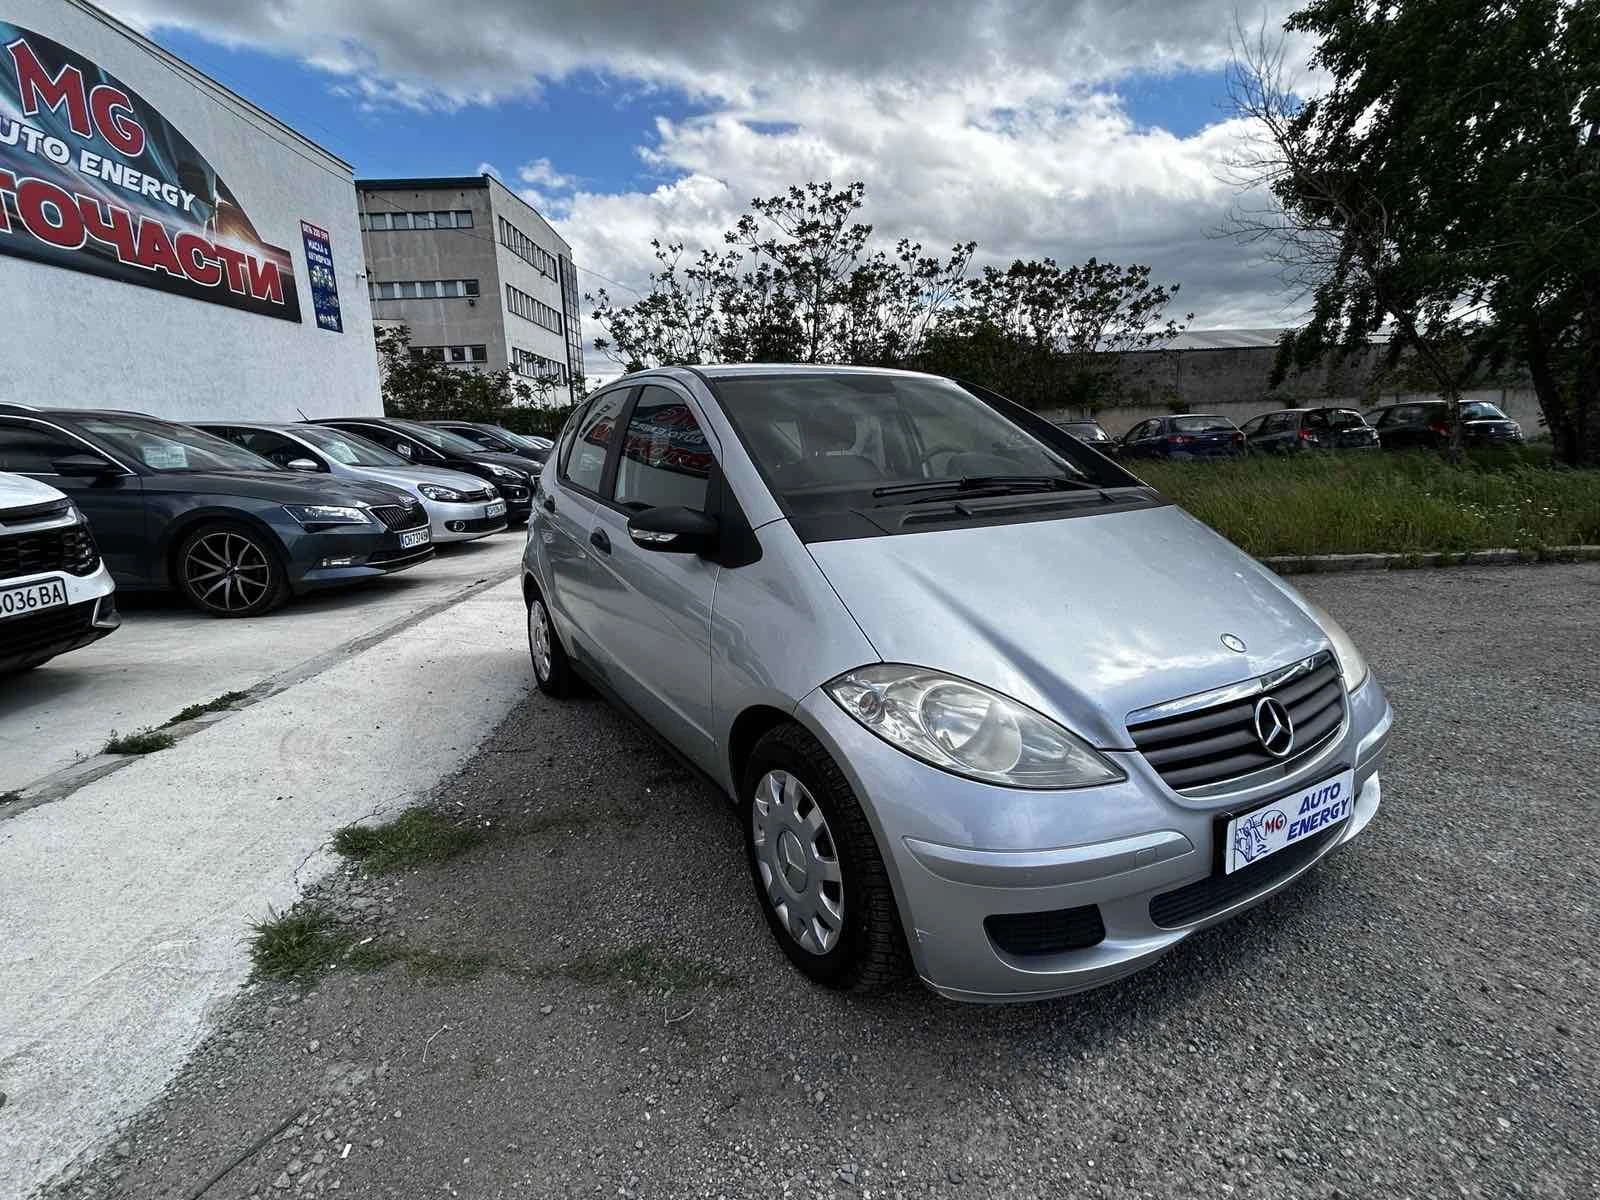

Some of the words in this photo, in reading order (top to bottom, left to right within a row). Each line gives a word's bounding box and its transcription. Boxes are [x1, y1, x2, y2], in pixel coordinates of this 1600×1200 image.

[6, 39, 145, 157] MG
[79, 149, 195, 211] ENERGY
[0, 588, 37, 614] 036
[39, 583, 63, 605] BA
[1298, 782, 1341, 815] AUTO
[1264, 815, 1283, 834] MG
[1287, 796, 1350, 841] ENERGY
